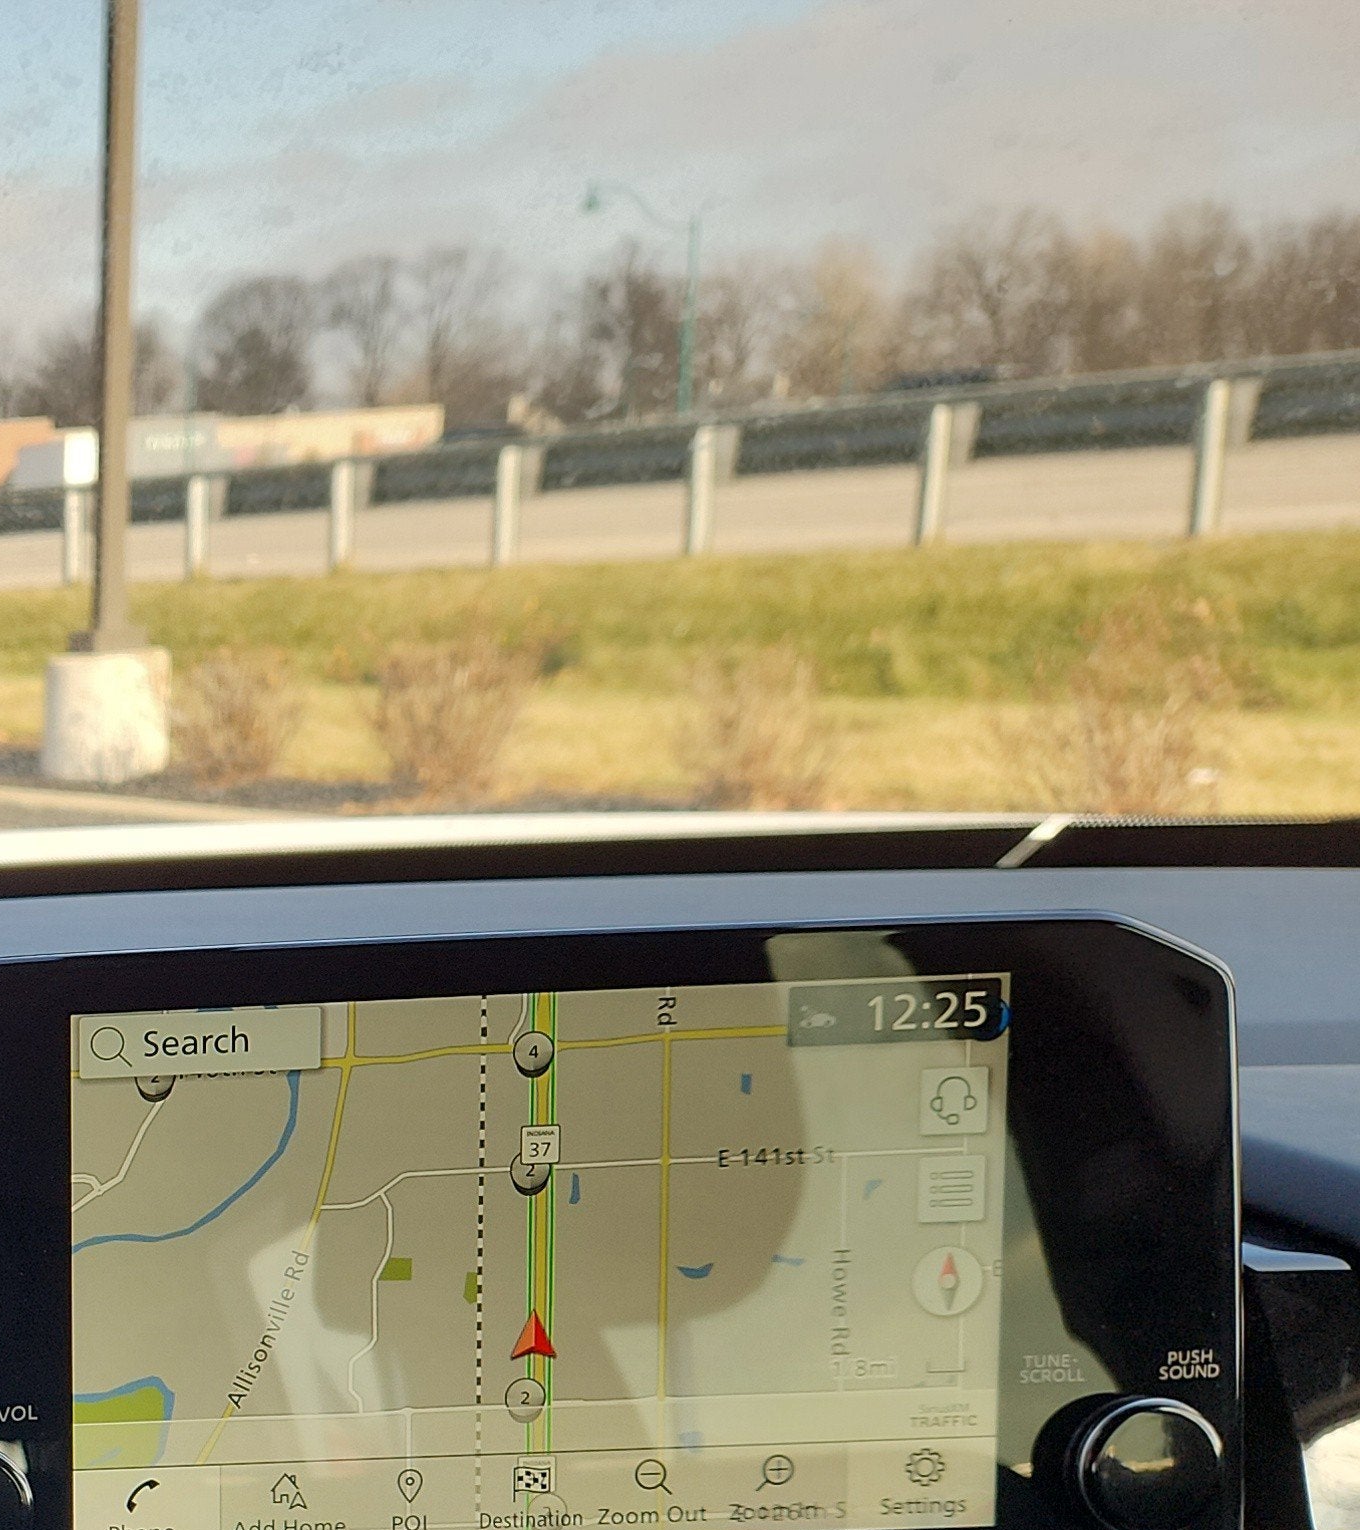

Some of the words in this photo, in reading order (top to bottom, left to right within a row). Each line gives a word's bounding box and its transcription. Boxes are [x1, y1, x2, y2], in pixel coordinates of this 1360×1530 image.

[656, 996, 677, 1026] Rd
[868, 990, 988, 1031] 12:25
[143, 1024, 249, 1057] Search
[528, 1043, 540, 1060] 4
[529, 1141, 551, 1157] 37
[717, 1149, 729, 1167] E
[739, 1147, 806, 1166] 141st
[831, 1248, 853, 1317] Howe
[226, 1285, 296, 1410] Allisonville
[284, 1251, 310, 1282] Rd
[830, 1327, 851, 1356] Rd
[1167, 1349, 1213, 1366] PUSH
[1019, 1366, 1087, 1384] SCROLL
[1158, 1363, 1221, 1381] SOUND
[520, 1391, 530, 1405] 2
[910, 1414, 978, 1428] TRAFFIC
[597, 1506, 660, 1526] Zoom
[667, 1505, 707, 1524] Out
[879, 1496, 968, 1518] Settings
[479, 1509, 583, 1529] Destination
